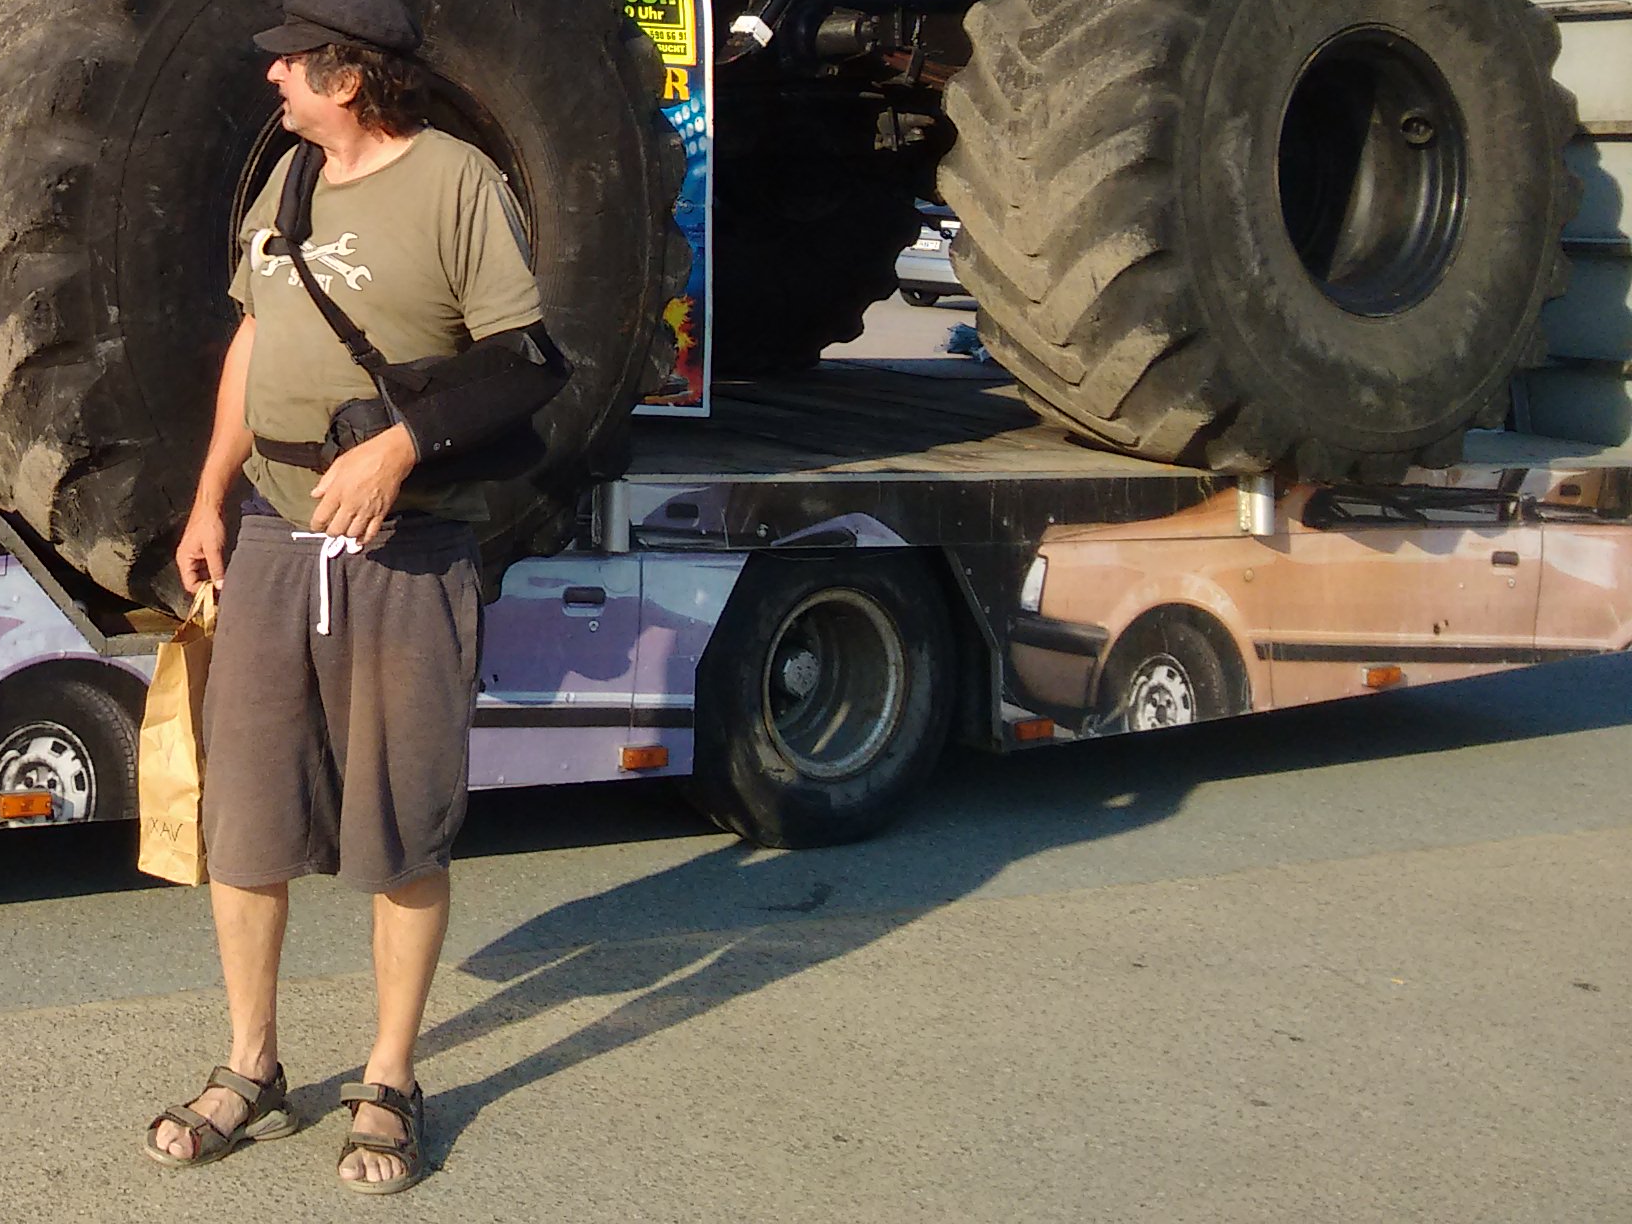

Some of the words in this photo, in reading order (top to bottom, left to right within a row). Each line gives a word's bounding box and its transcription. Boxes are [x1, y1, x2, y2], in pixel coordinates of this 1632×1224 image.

[638, 5, 665, 20] Uhr
[657, 43, 685, 53] SUCHT
[663, 67, 690, 101] R
